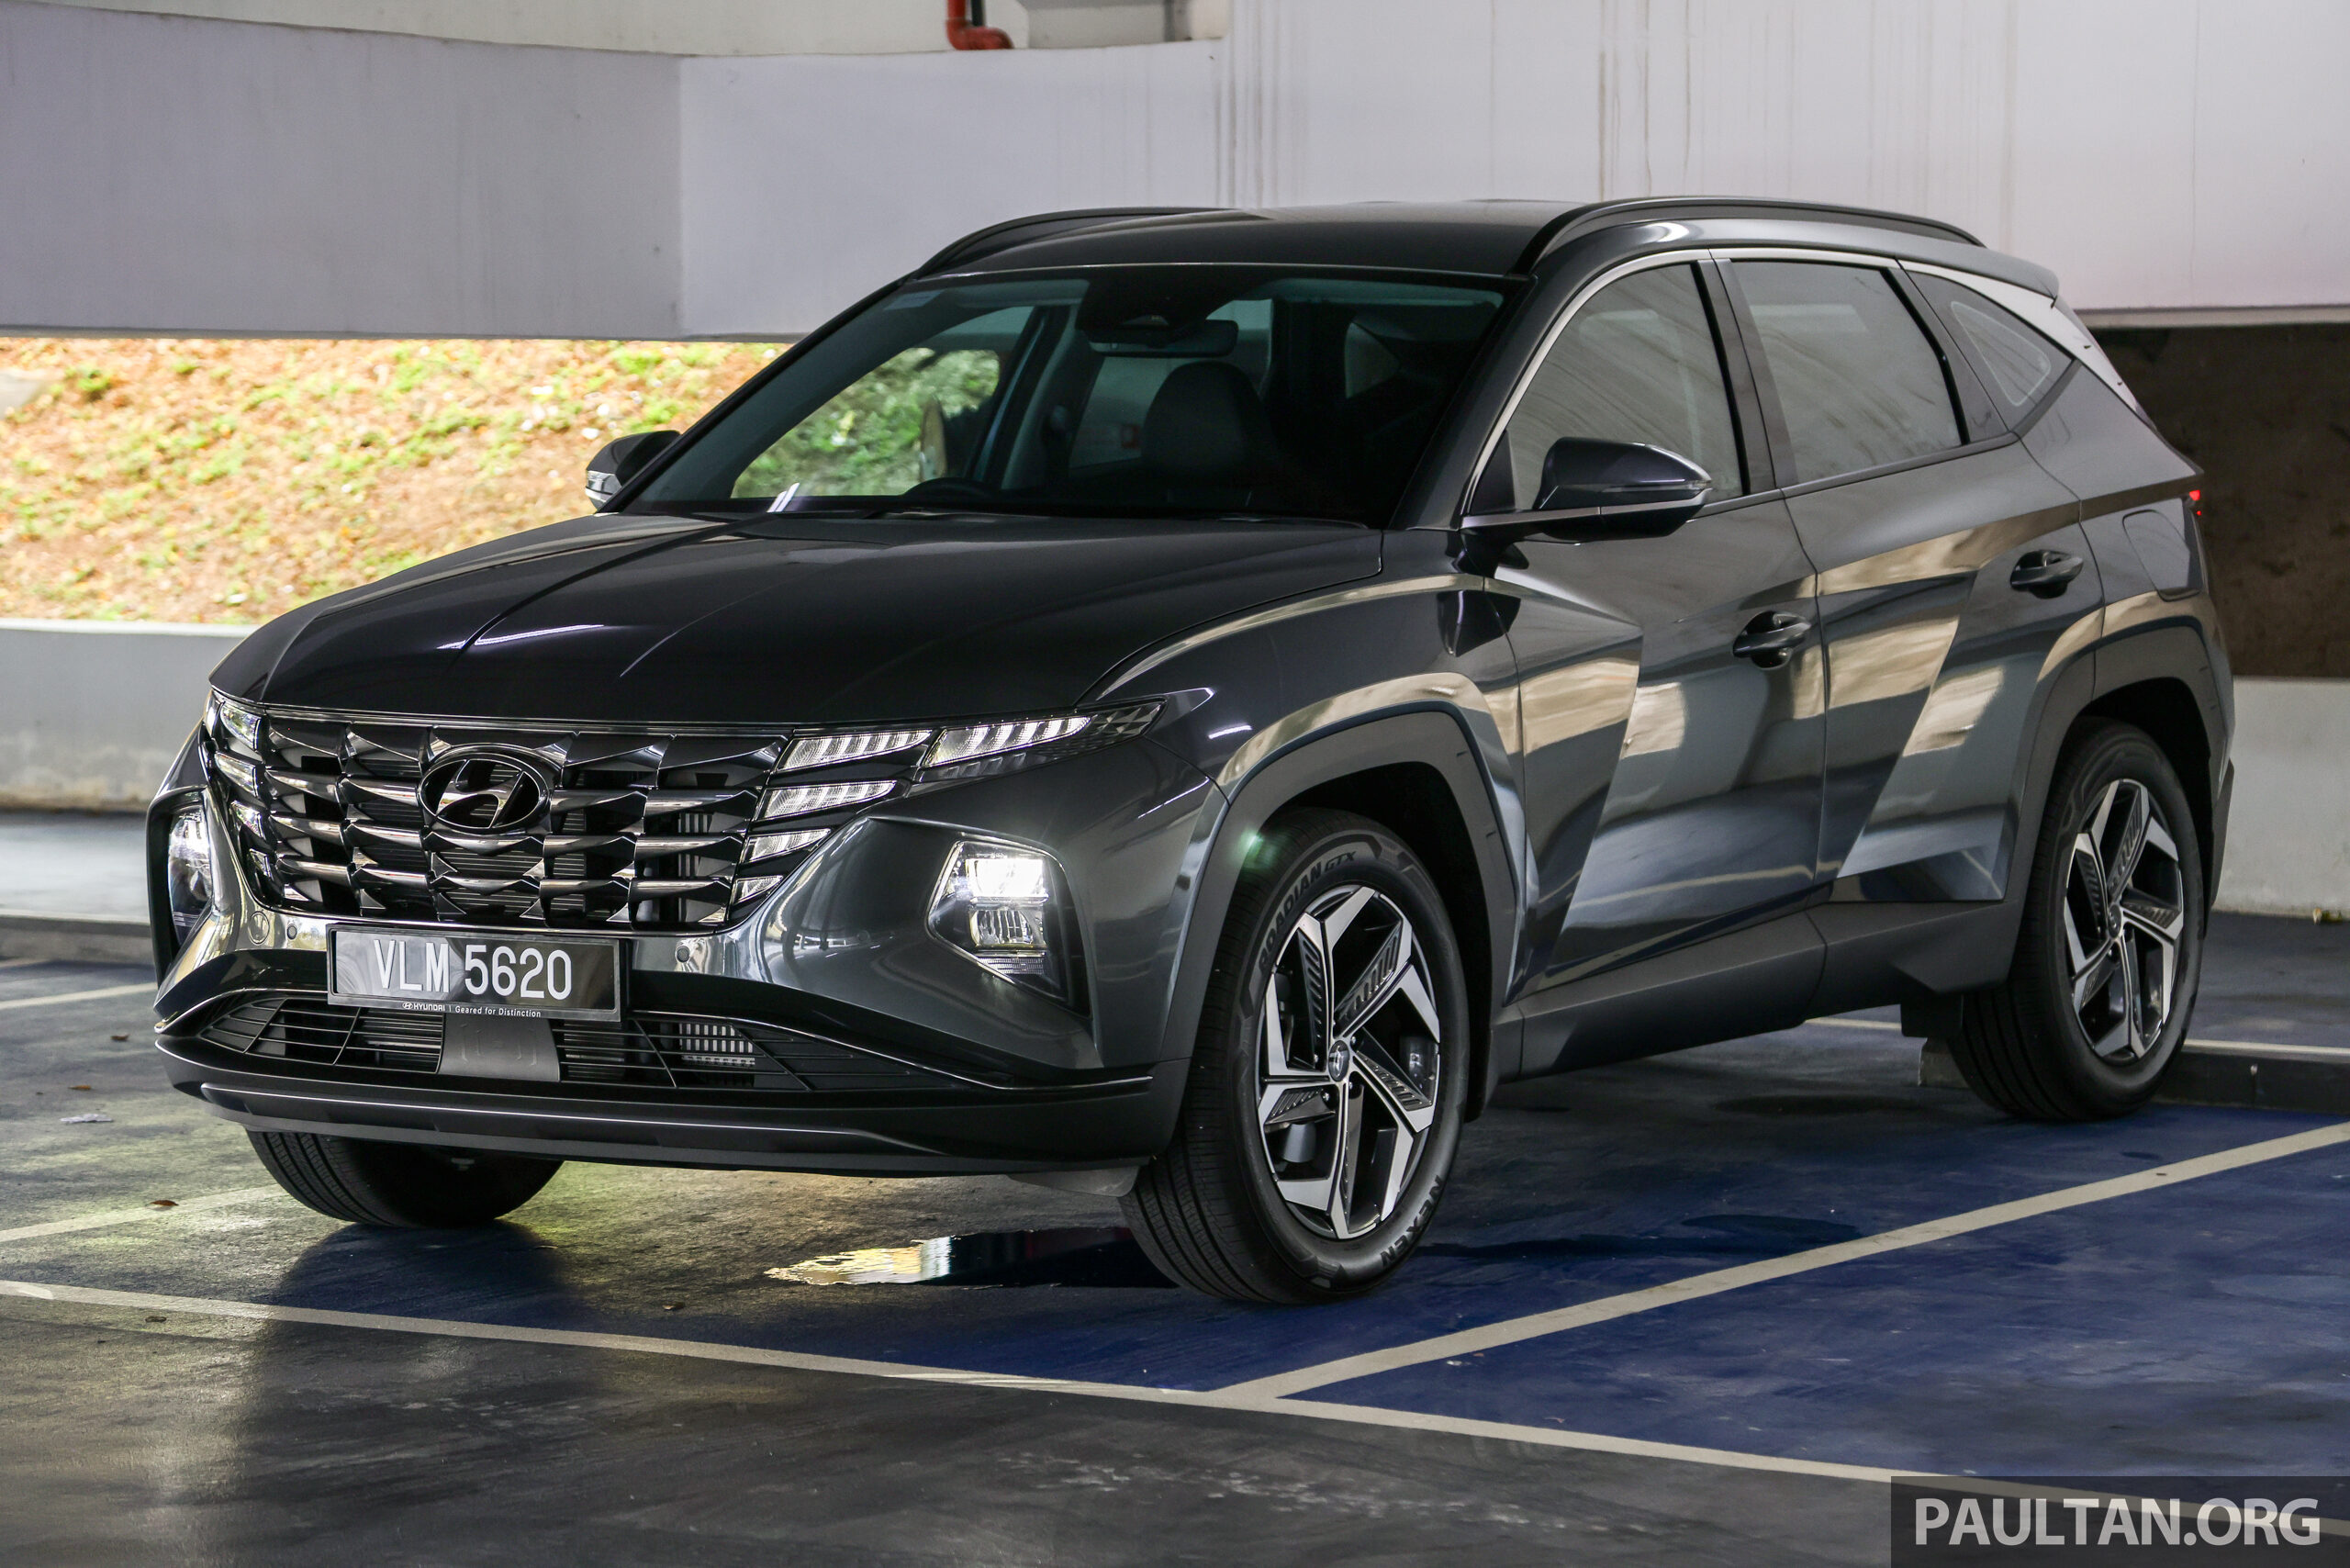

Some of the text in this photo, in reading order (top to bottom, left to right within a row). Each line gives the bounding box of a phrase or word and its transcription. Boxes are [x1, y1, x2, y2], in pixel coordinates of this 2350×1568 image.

[1259, 851, 1357, 974] ROADIAN GTX
[374, 939, 572, 1001] VLM 5620
[413, 1002, 542, 1018] HYUNDAI Geared for Distinction
[1380, 1175, 1445, 1268] NEXEN
